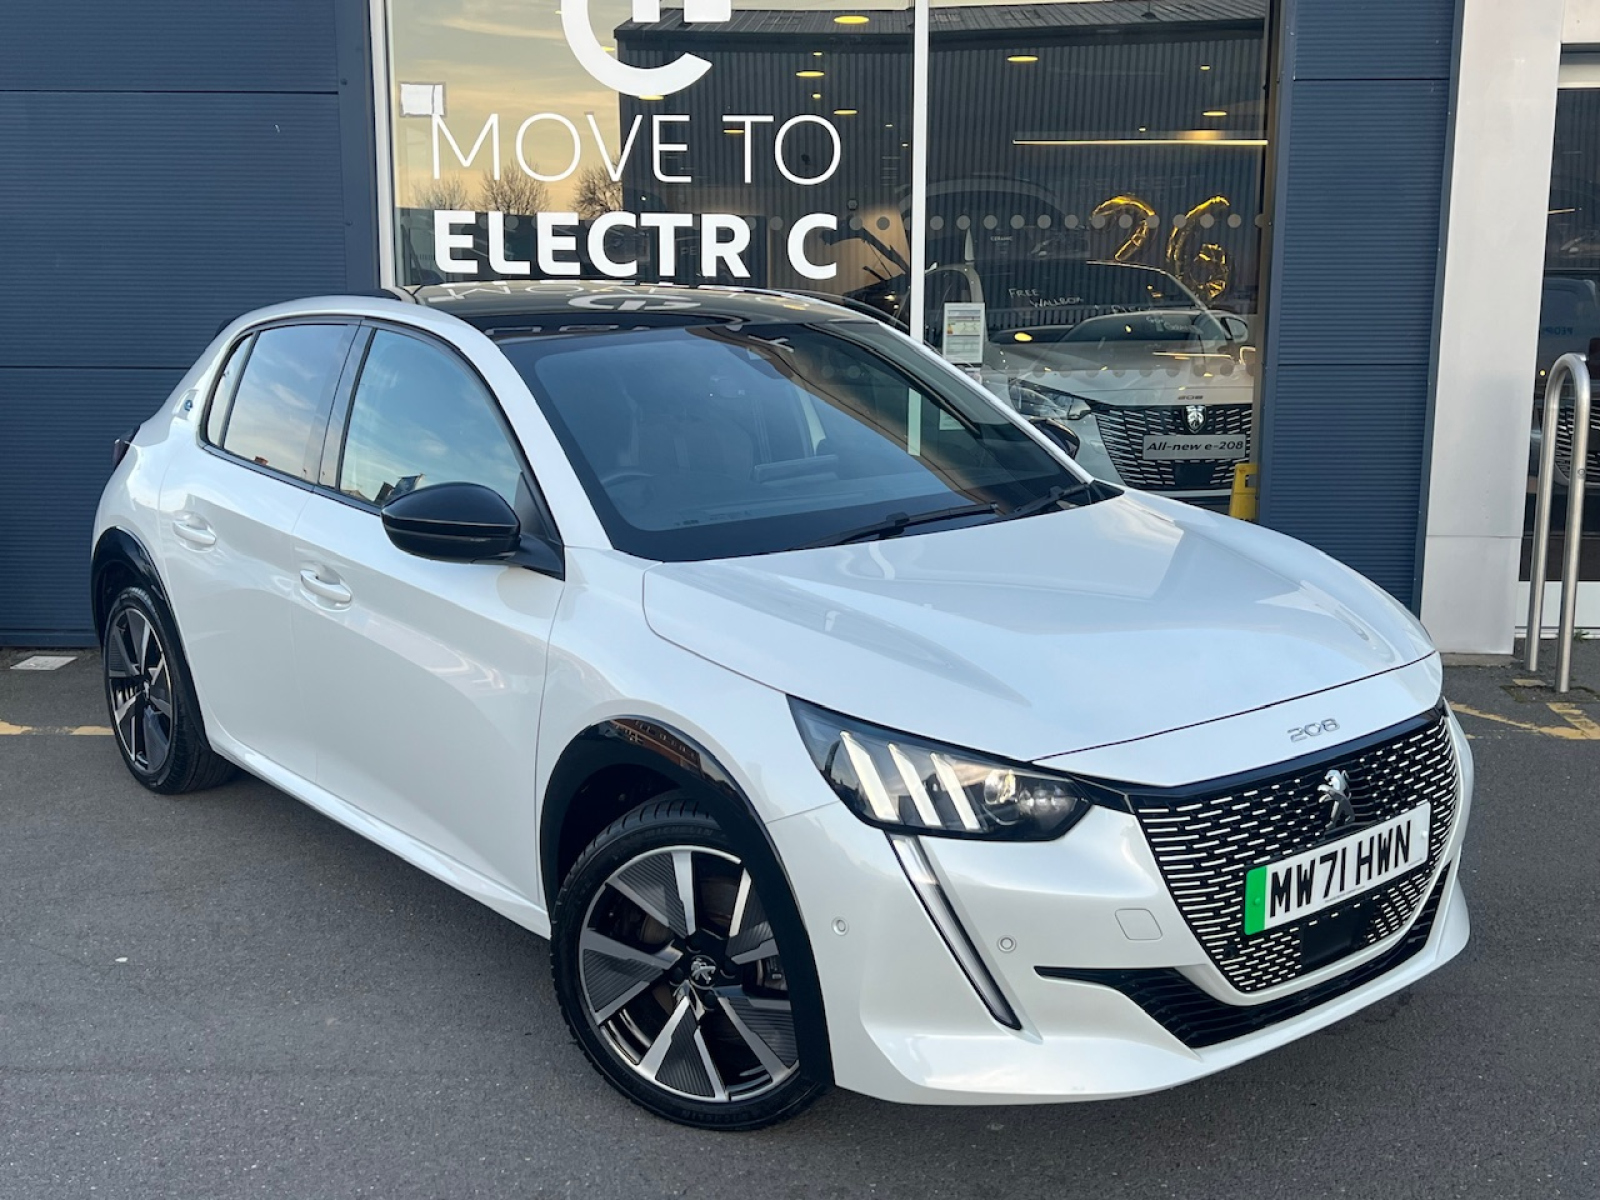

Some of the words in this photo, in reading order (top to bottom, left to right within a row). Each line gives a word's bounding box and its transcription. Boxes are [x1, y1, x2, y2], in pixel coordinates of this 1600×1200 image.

[431, 113, 692, 183] MOVE
[722, 114, 842, 186] TO
[1008, 287, 1040, 298] FREE
[1146, 441, 1201, 451] All-new
[1204, 440, 1244, 451] e-208
[1287, 718, 1340, 743] 208
[1269, 846, 1347, 918] MW71
[1355, 819, 1412, 886] HWN
